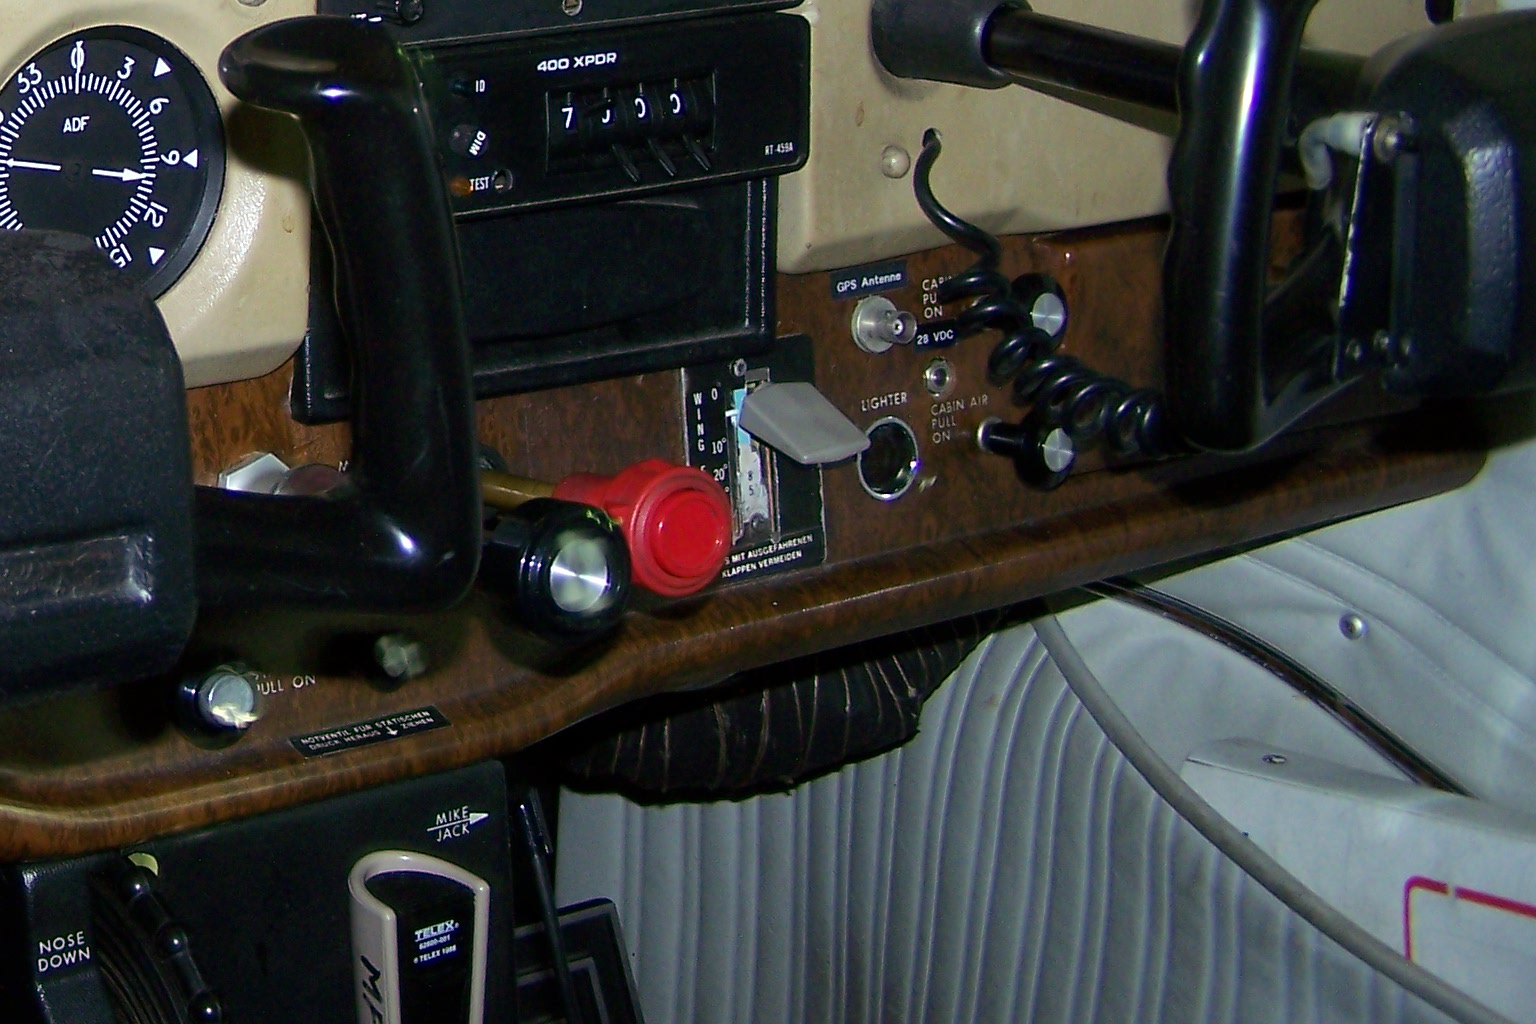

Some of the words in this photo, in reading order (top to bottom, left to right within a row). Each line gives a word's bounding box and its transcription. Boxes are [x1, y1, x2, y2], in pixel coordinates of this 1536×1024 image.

[537, 56, 570, 72] 400
[573, 52, 618, 70] XPDR
[475, 79, 486, 93] ID
[63, 115, 90, 133] ADF
[468, 130, 487, 157] DIM
[469, 176, 490, 192] TEST
[836, 281, 857, 293] GPS
[861, 272, 902, 289] Antenne
[916, 334, 929, 345] 28
[932, 329, 954, 342] VDC
[861, 392, 908, 412] LIGHTER
[931, 400, 964, 417] CABIN
[970, 394, 989, 406] AIR
[931, 417, 956, 429] PULL
[932, 430, 951, 444] ON
[731, 551, 745, 564] MIT
[747, 533, 814, 558] AUSGEFAHRENEN
[722, 561, 757, 578] KLAPPEN
[759, 549, 802, 569] VERMEIDEN
[436, 806, 470, 827] MIKE
[436, 821, 471, 843] JACK
[39, 931, 87, 955] NOSE
[37, 946, 92, 972] DOWN
